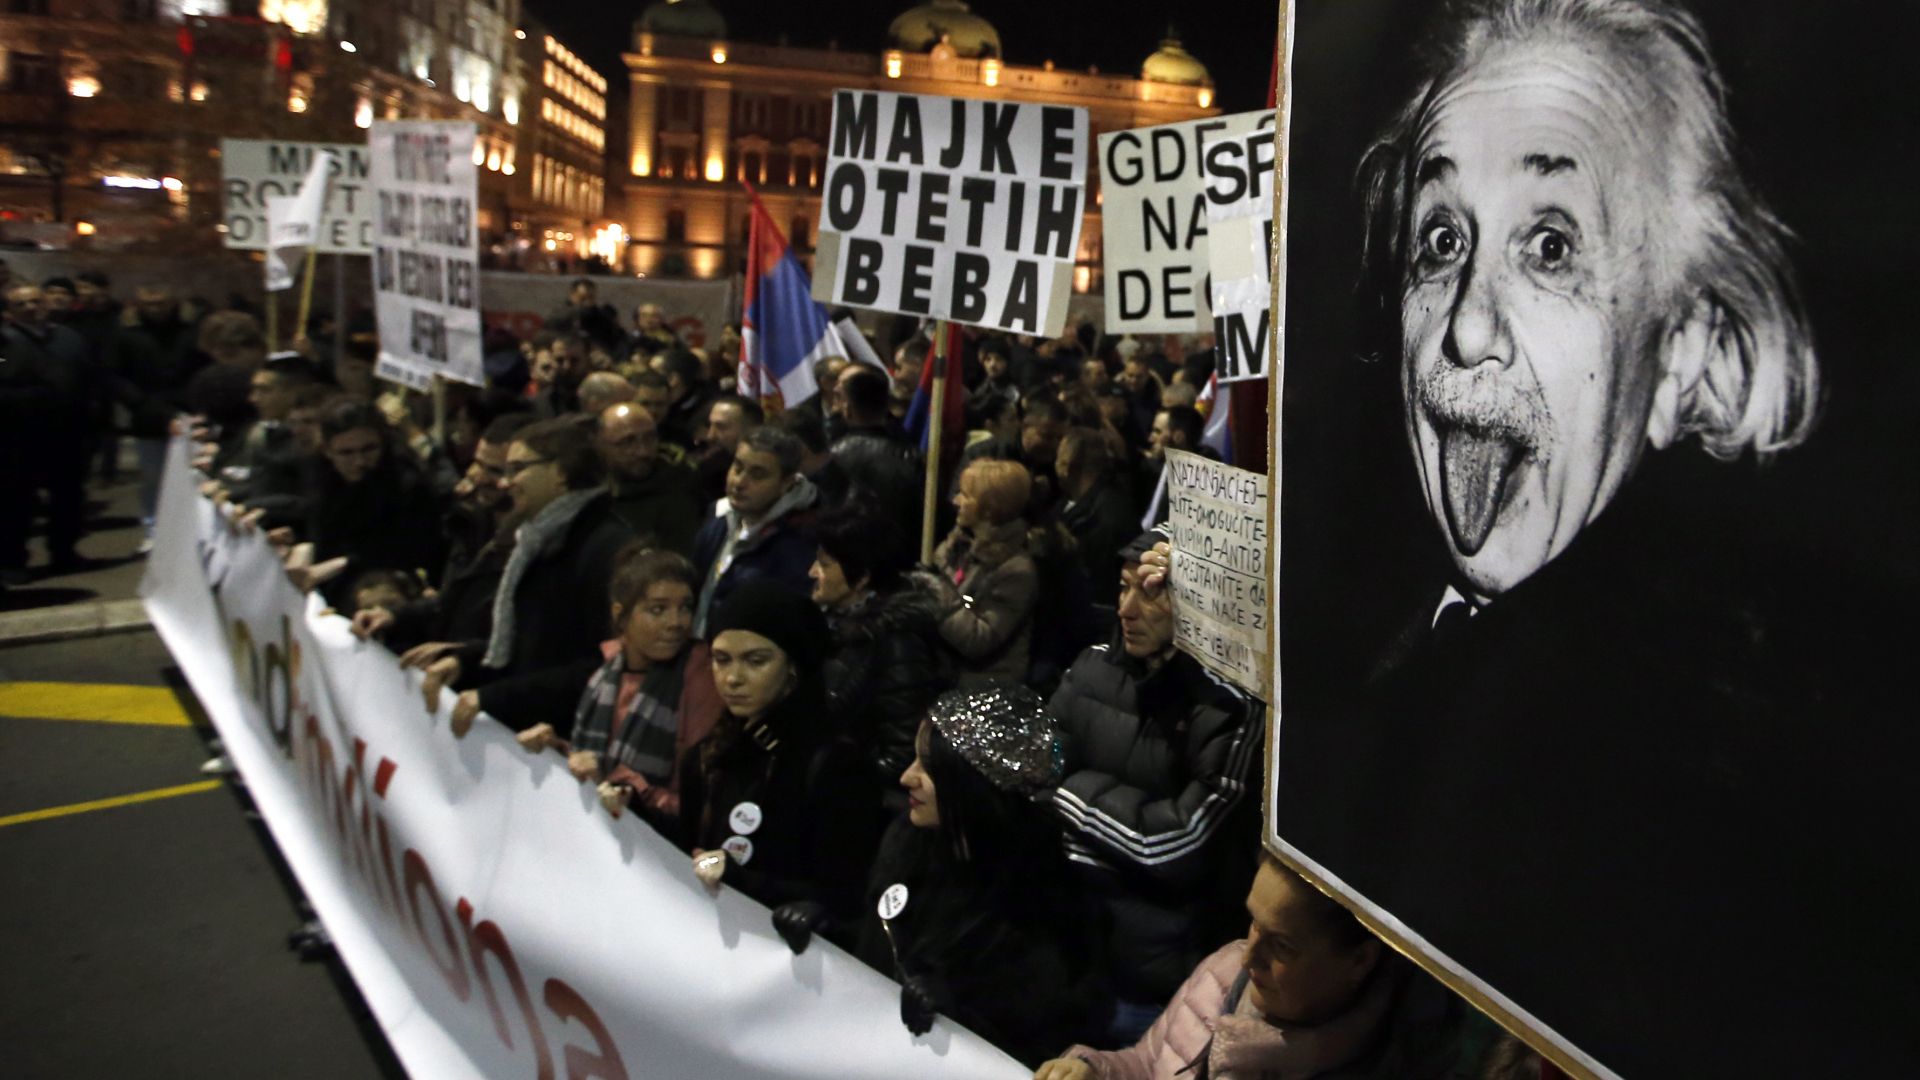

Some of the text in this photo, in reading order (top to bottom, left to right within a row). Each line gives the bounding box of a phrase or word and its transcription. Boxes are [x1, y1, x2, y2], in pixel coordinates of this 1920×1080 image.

[833, 92, 1075, 180] MAJKE
[828, 162, 1078, 259] OTETIH
[842, 237, 1039, 333] BEBA
[1118, 266, 1212, 321] DE
